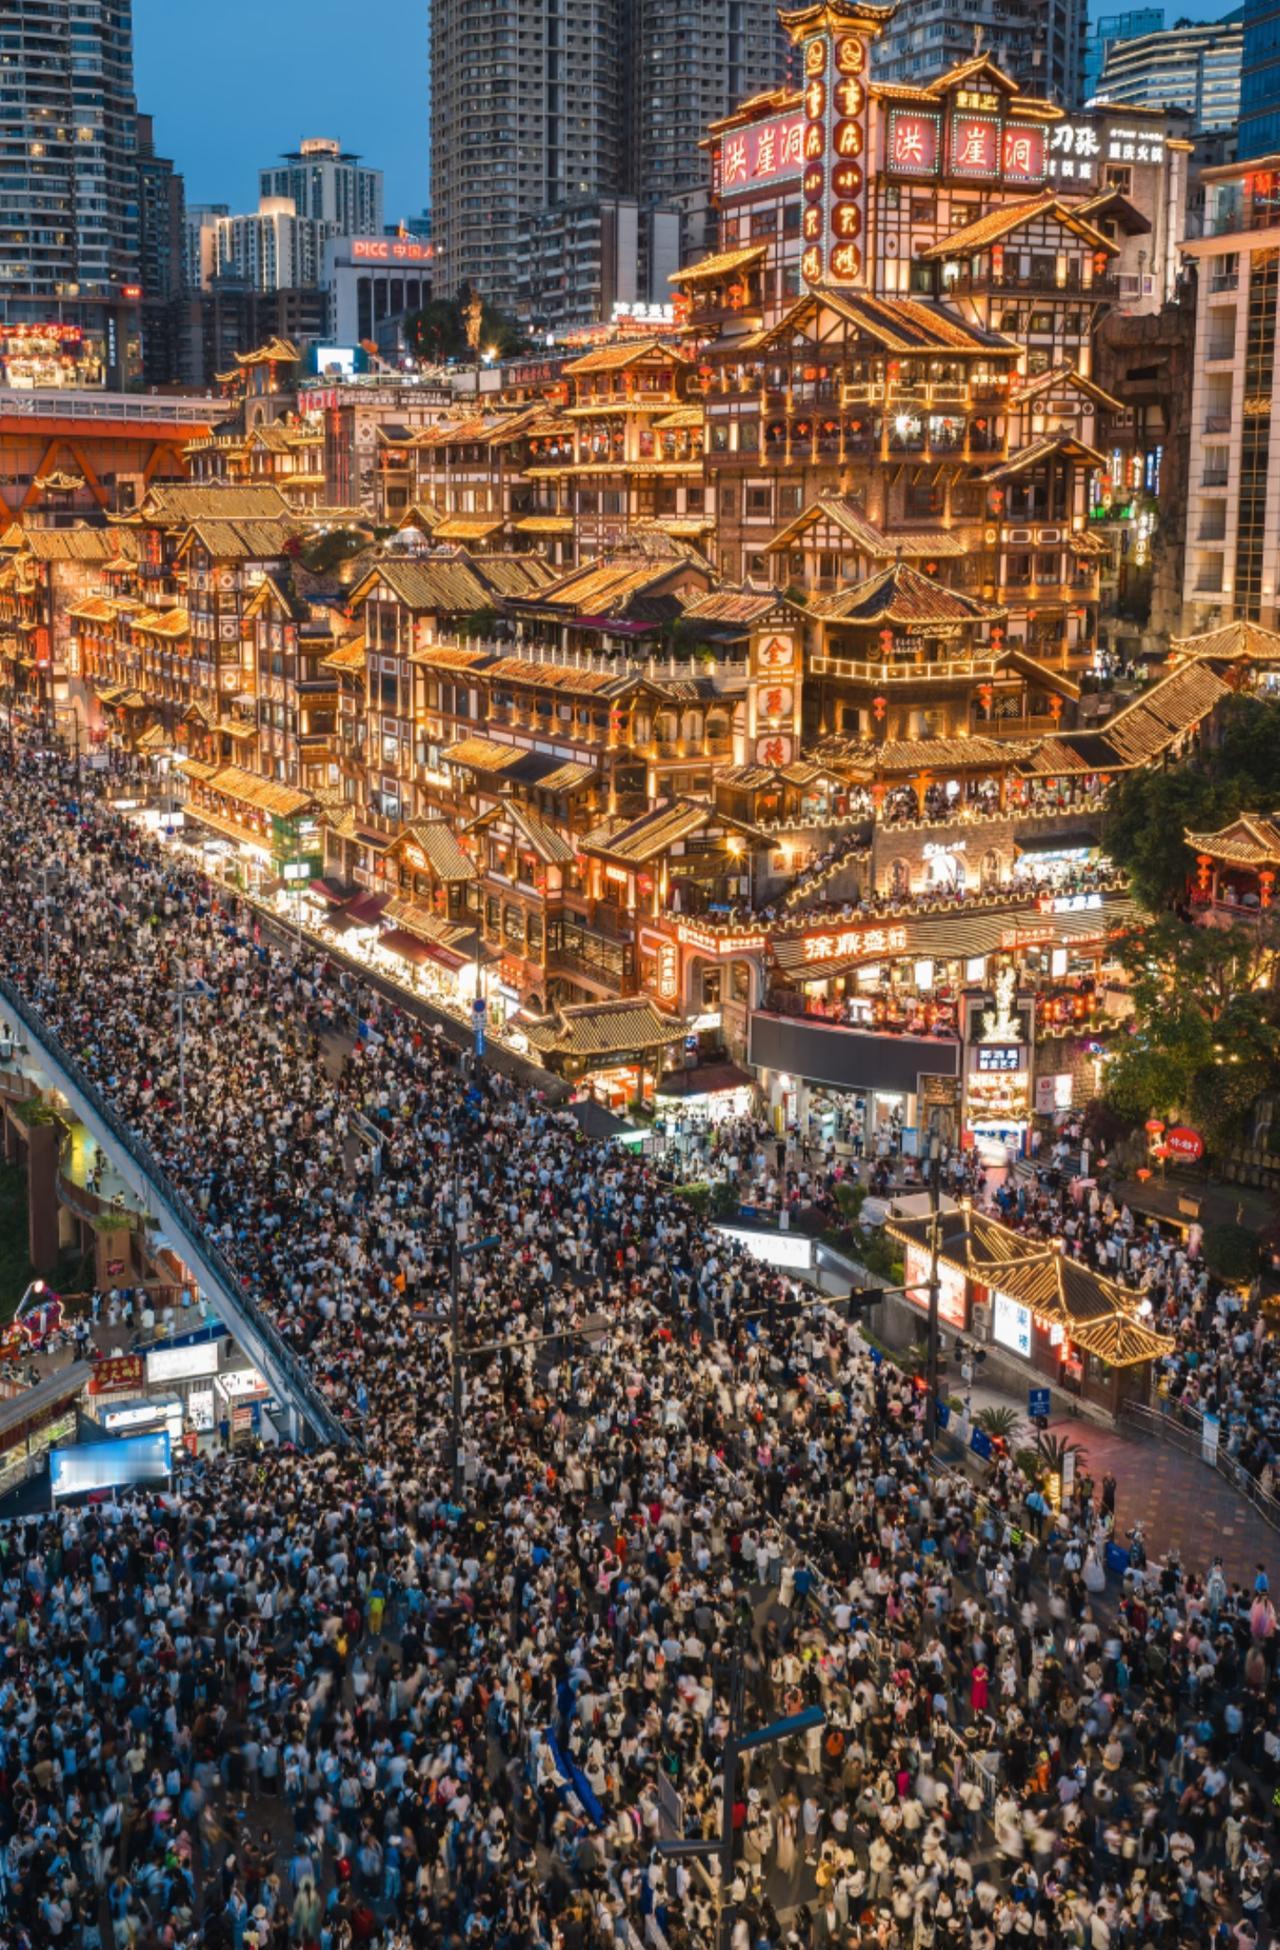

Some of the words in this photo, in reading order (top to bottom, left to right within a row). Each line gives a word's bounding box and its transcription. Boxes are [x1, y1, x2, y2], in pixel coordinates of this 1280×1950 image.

[724, 122, 805, 184] 洪崖洞
[896, 124, 1031, 172] 洪崖洞
[354, 241, 388, 257] PICC
